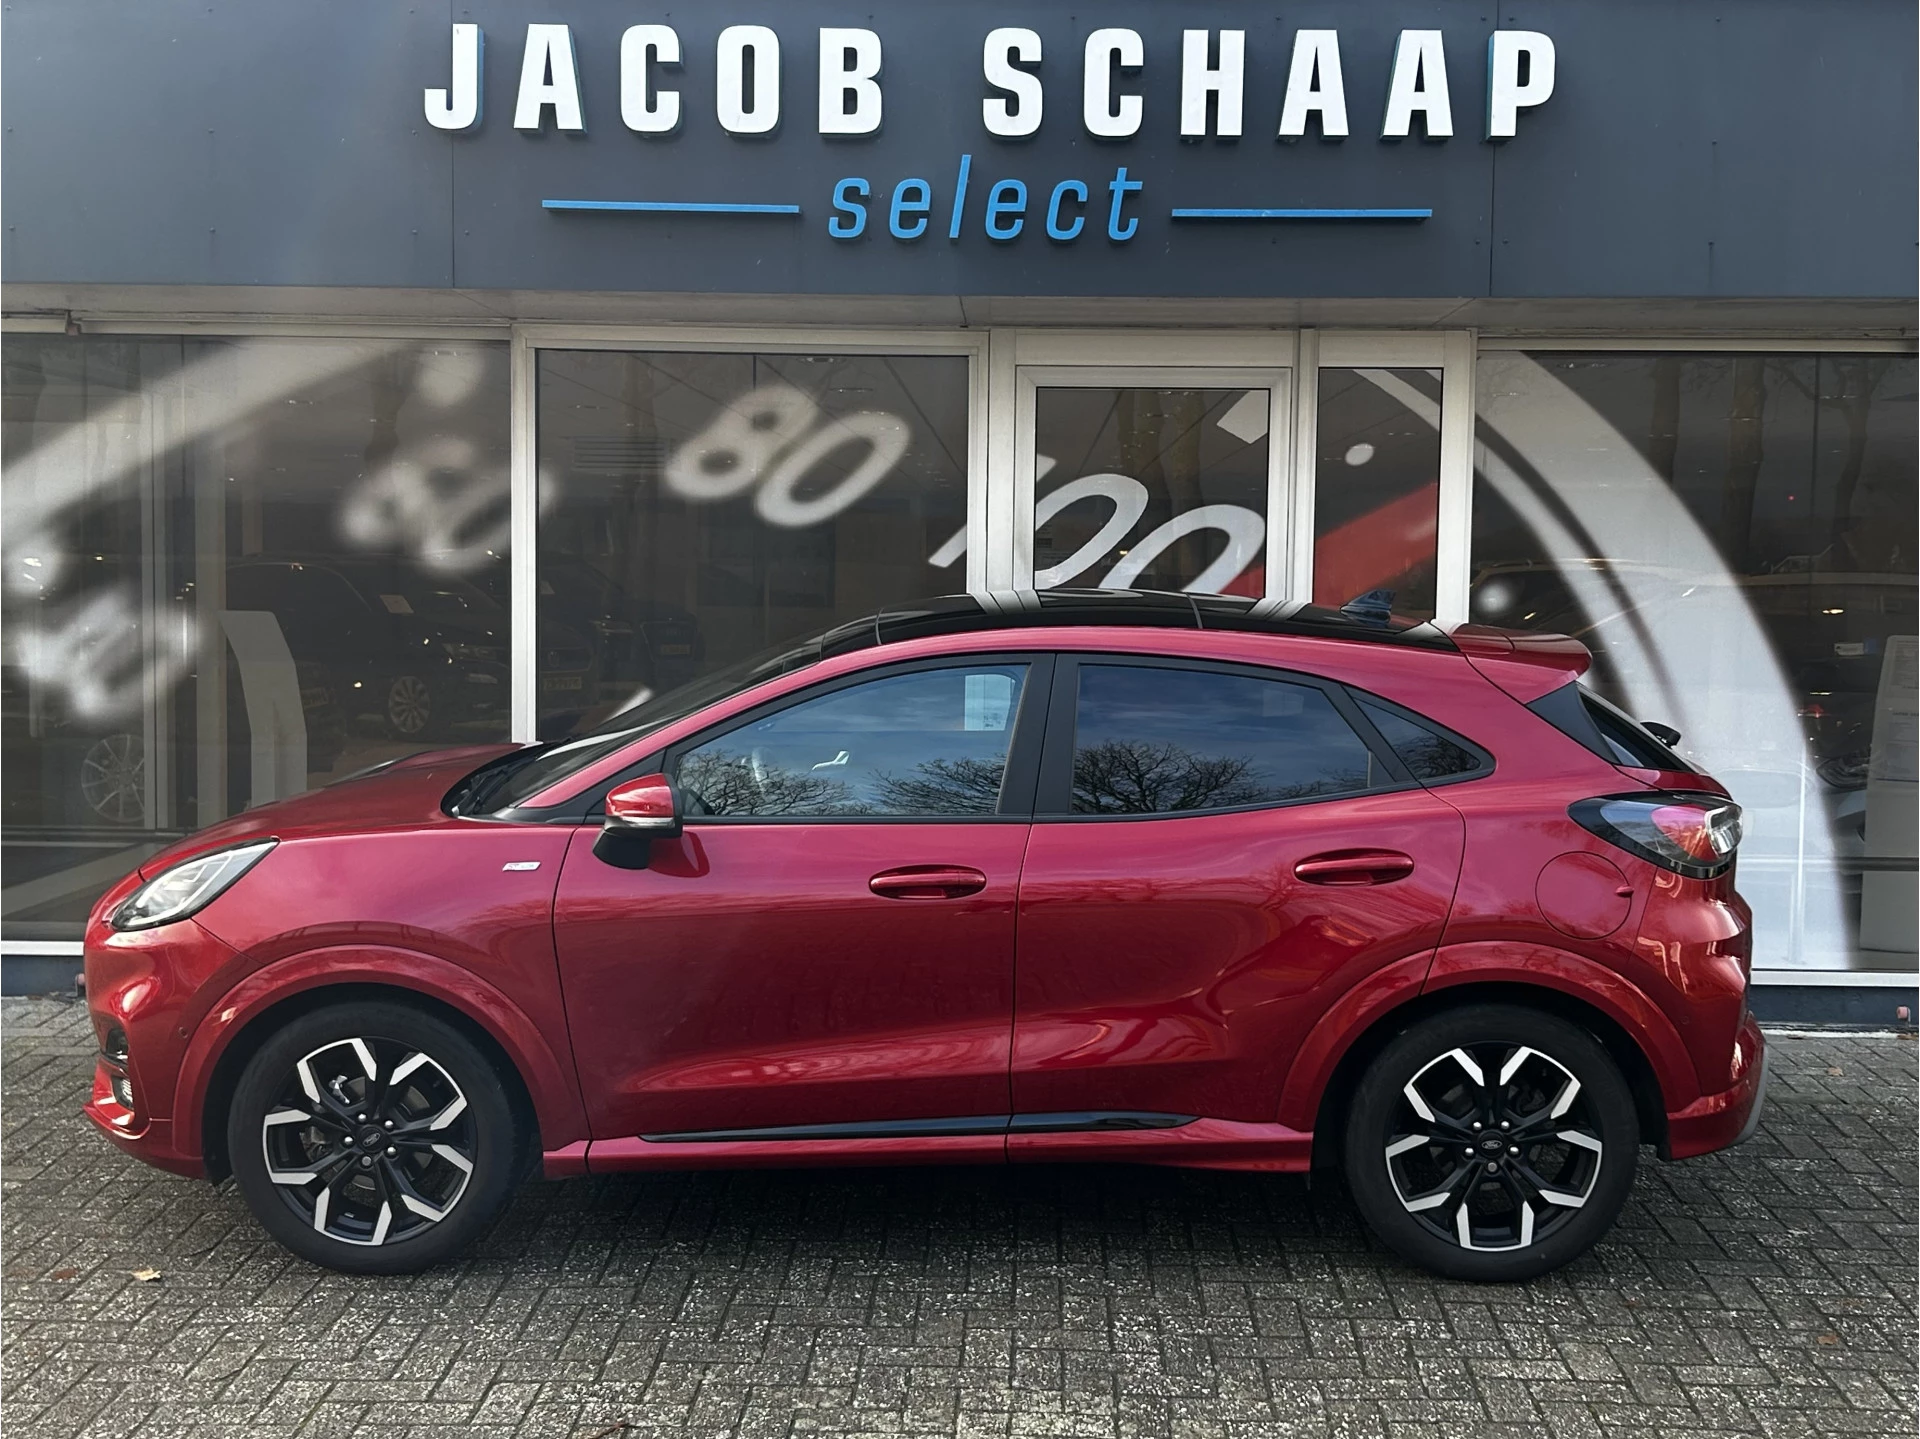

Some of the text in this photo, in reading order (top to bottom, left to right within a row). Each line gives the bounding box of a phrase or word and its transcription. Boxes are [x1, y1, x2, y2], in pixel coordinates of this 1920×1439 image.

[424, 22, 1557, 138] JACOB SCHAAP
[828, 154, 1144, 241] select
[664, 384, 911, 527] 80
